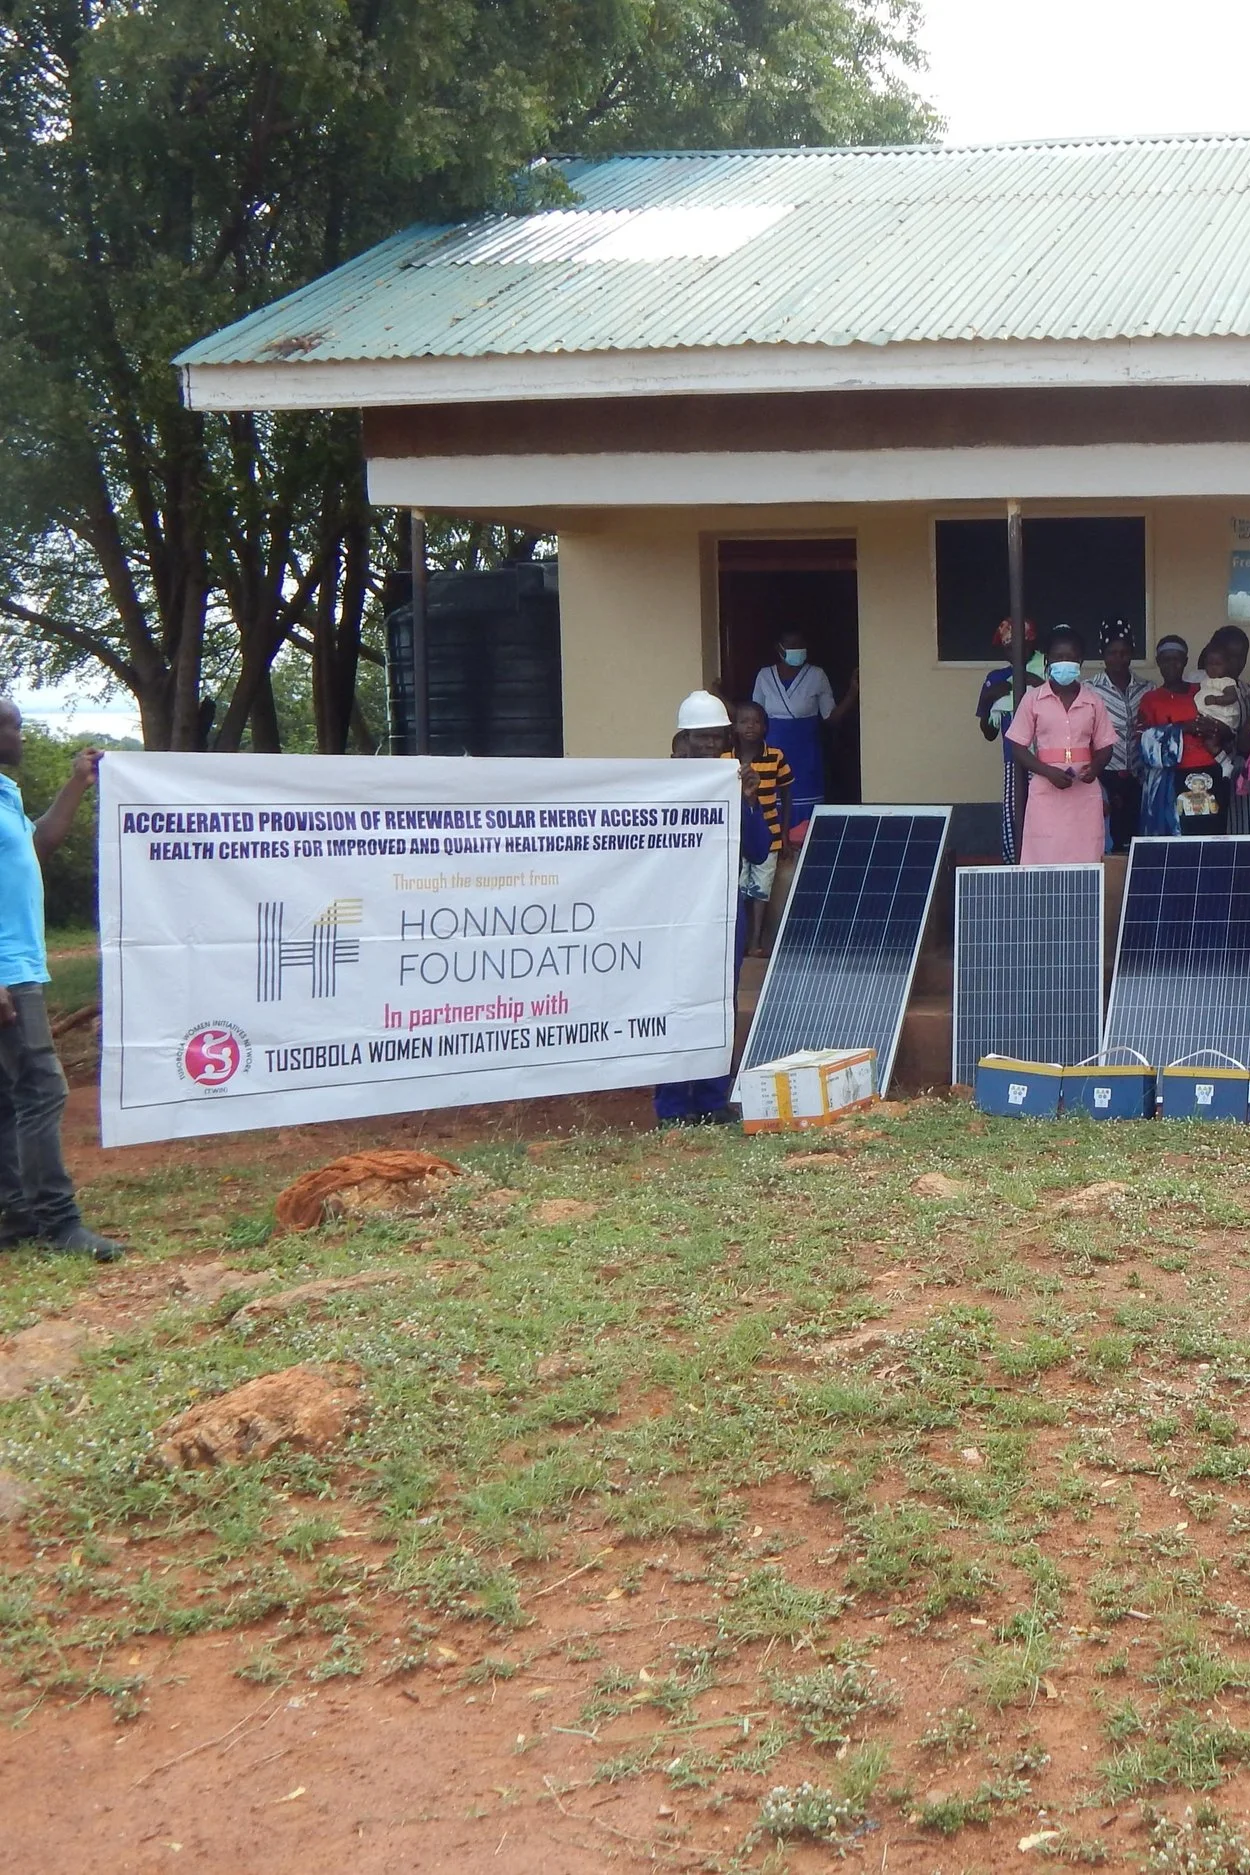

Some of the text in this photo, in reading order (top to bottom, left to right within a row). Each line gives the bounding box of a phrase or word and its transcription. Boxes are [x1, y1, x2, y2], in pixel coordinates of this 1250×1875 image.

[123, 807, 725, 834] ACCELERATED PROVISION OF RENEWABLE SOLAR ENERGY ACCESS TO RURAL
[149, 832, 703, 861] HEALTH CENTRES FOR IMPROVED AND QUALITY HEALTHCARE SERVICE DELIVERY
[393, 870, 560, 893] Through the support from
[401, 902, 595, 941] HONNOLD
[400, 941, 642, 986] FOUNDATION
[384, 991, 569, 1032] In partnership with
[184, 1020, 211, 1040] WOMEN
[265, 1043, 362, 1073] TUSOBOLA
[369, 1036, 433, 1063] WOMEN
[438, 1028, 530, 1057] INITIATIVES
[536, 1021, 609, 1048] NETWORK
[628, 1016, 667, 1039] TWIN
